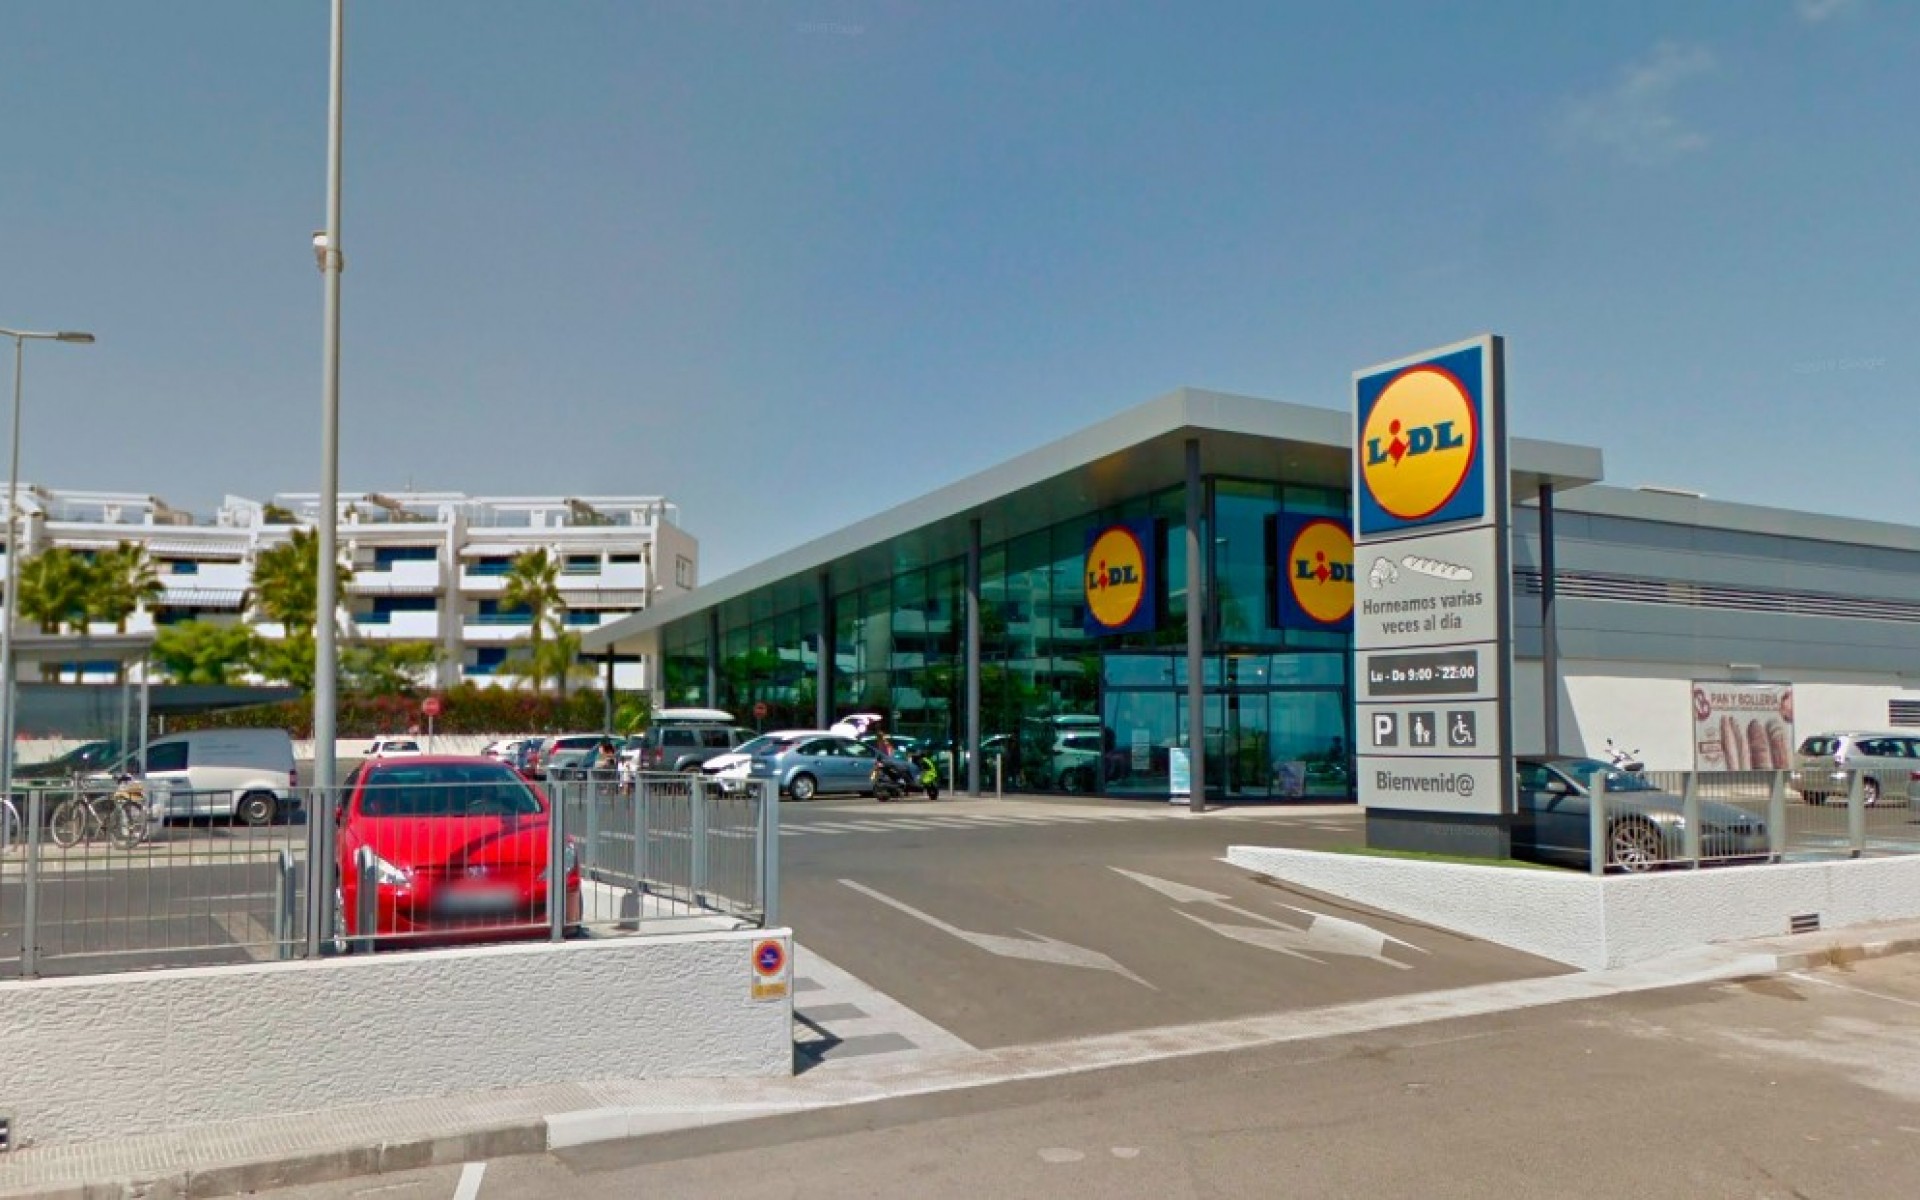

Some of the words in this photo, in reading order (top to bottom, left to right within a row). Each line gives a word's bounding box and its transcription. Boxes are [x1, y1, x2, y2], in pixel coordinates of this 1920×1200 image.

[1363, 597, 1436, 615] Horneamos
[1440, 589, 1482, 609] varias
[1382, 620, 1420, 634] veces
[1423, 614, 1436, 631] al
[1441, 612, 1462, 630] día
[1371, 670, 1383, 682] Lu
[1407, 668, 1432, 681] 9:00
[1442, 665, 1475, 679] 22:00
[1375, 714, 1393, 744] P
[1376, 770, 1474, 796] Bienvenid@
